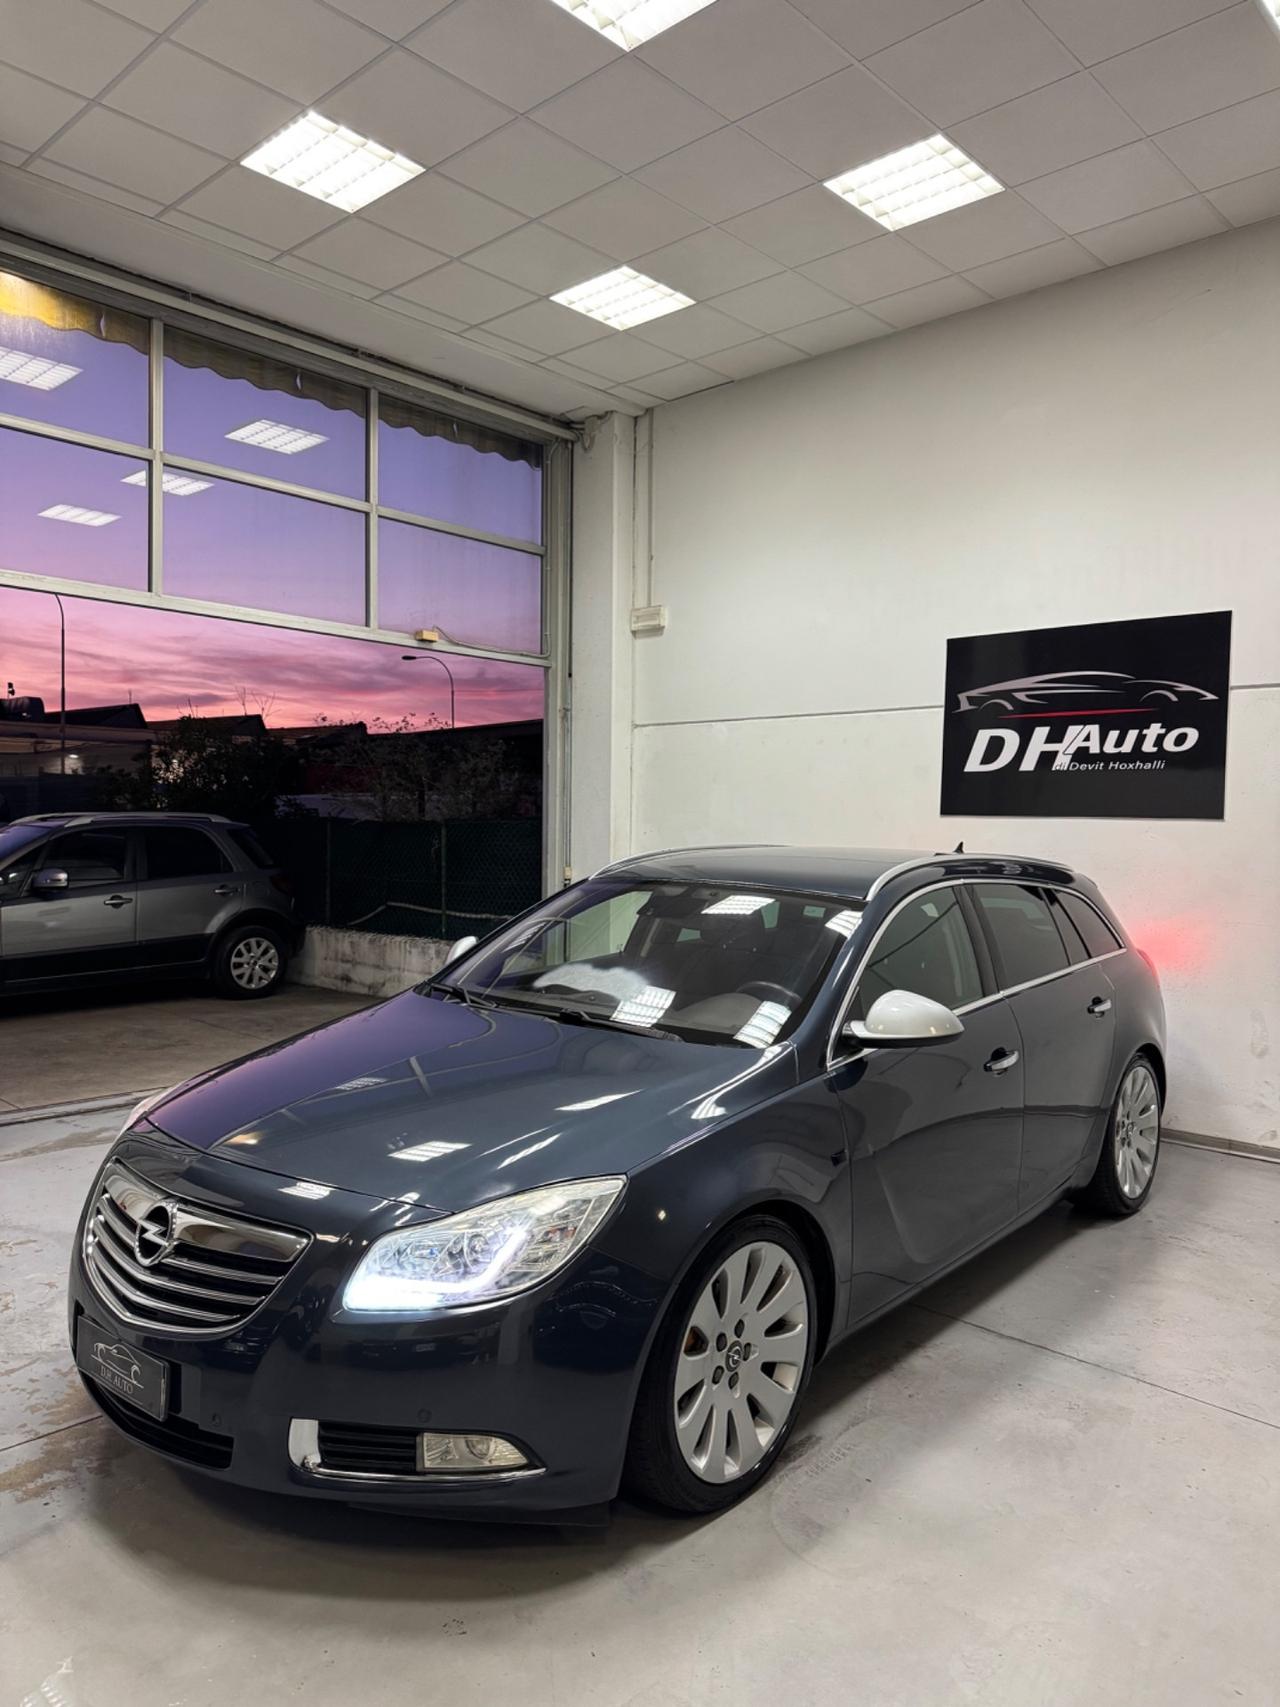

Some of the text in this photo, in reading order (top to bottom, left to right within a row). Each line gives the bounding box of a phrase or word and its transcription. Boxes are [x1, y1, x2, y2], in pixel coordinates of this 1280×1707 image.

[1069, 760, 1105, 771] Devit
[1108, 759, 1166, 770] Hoxhalli
[112, 1375, 133, 1394] AUTO
